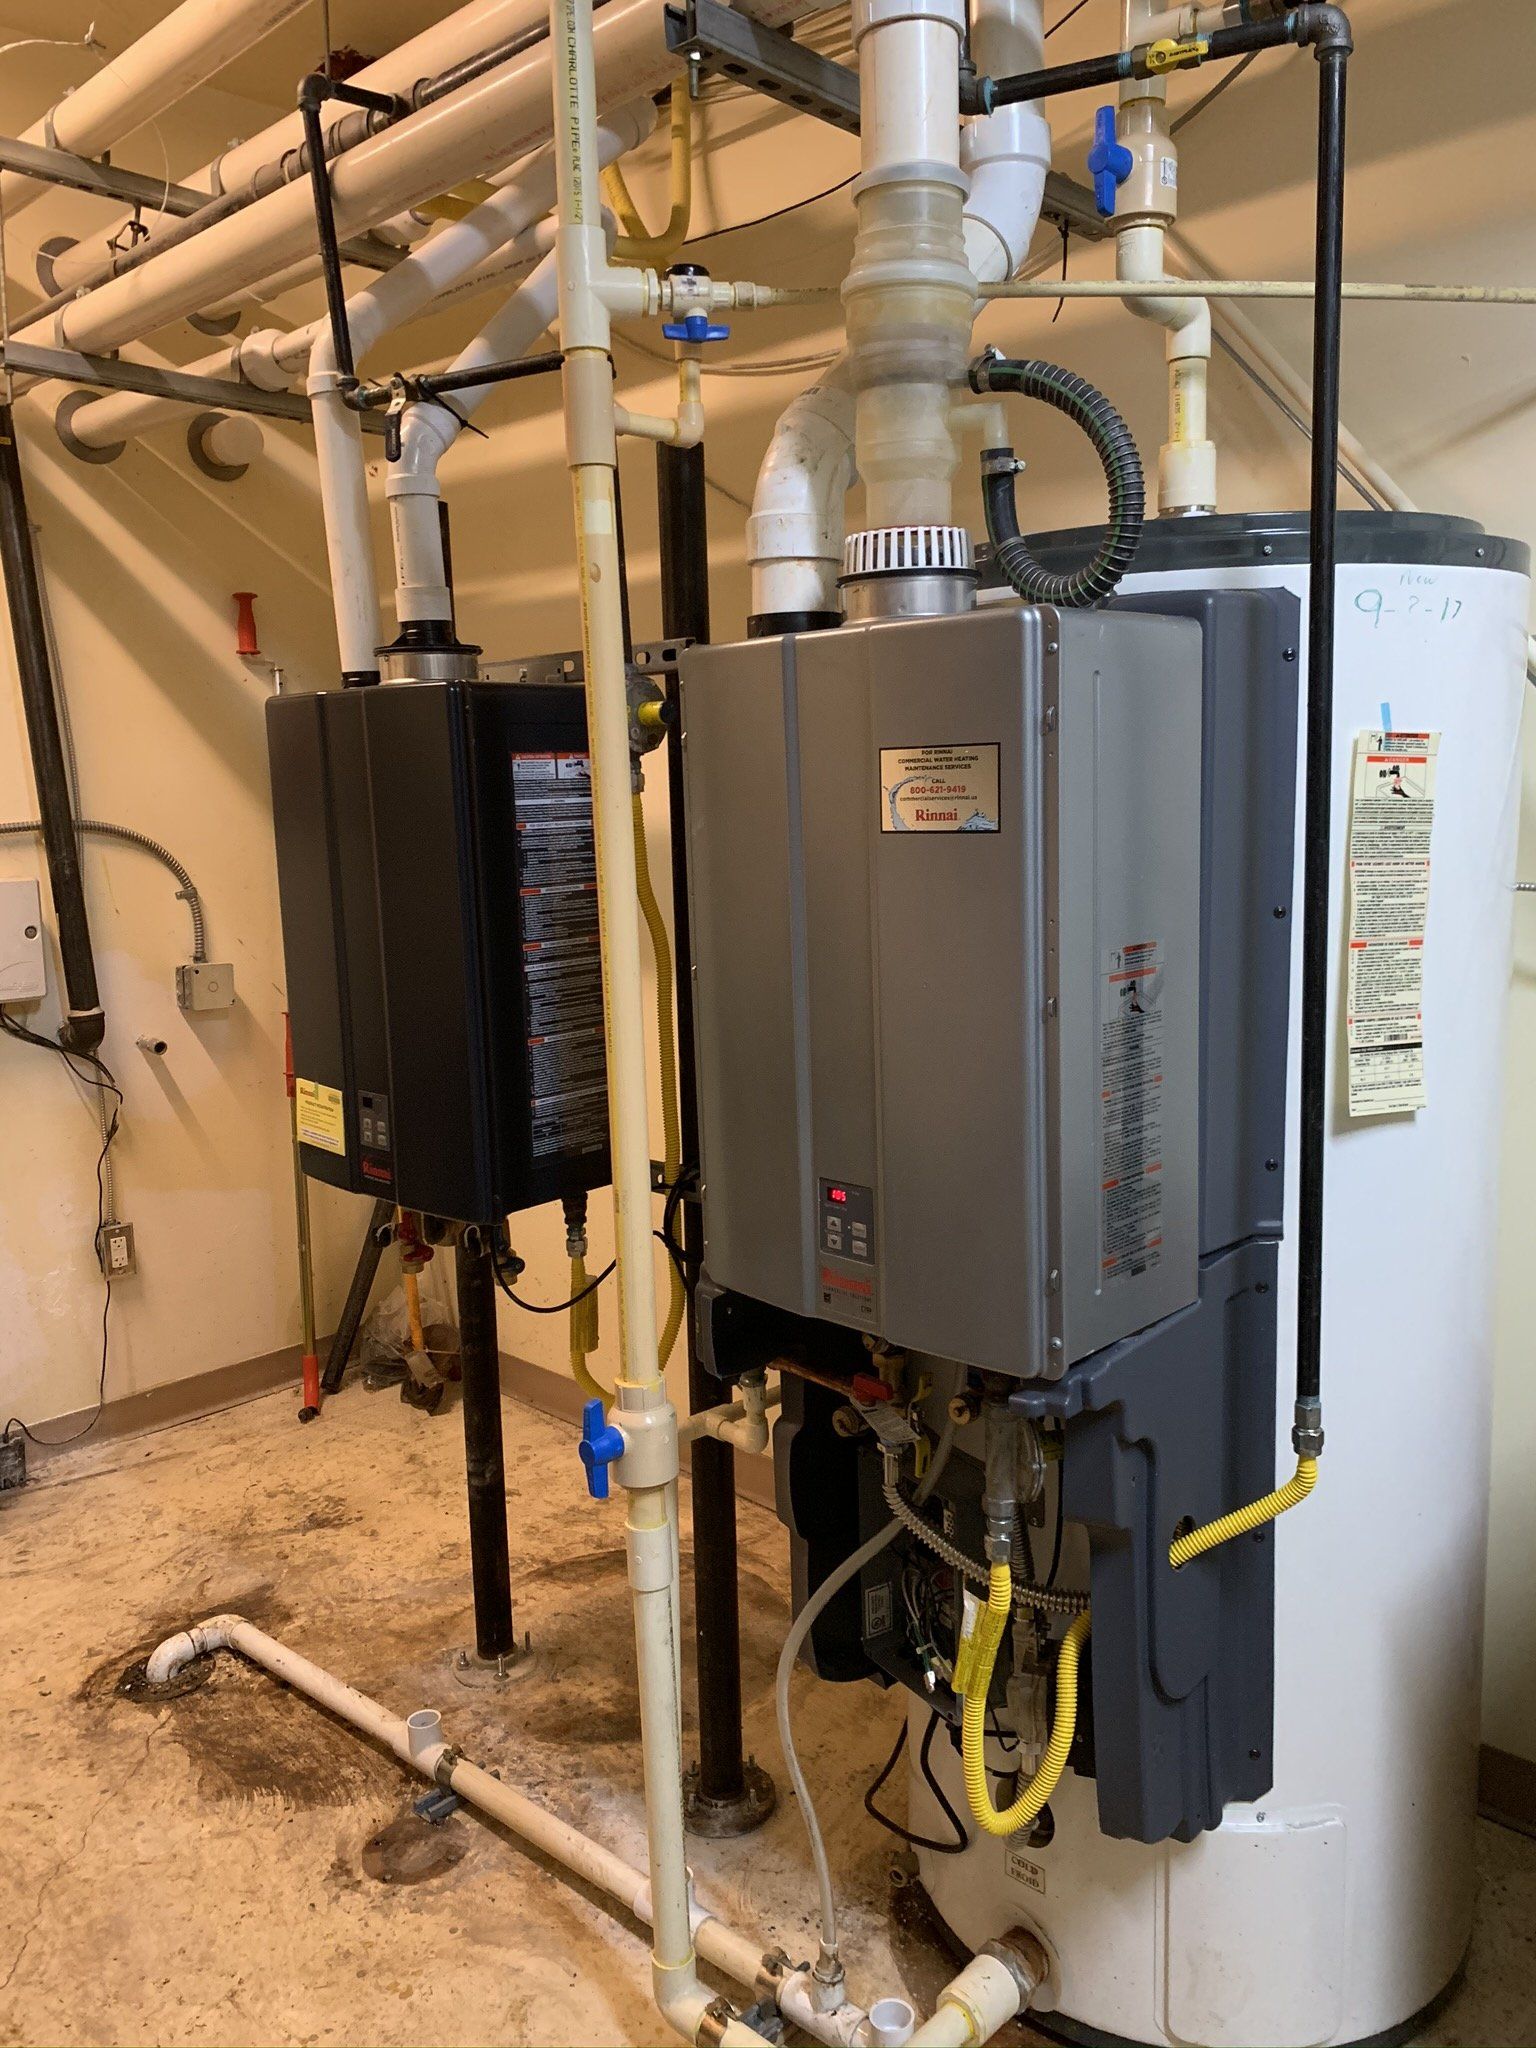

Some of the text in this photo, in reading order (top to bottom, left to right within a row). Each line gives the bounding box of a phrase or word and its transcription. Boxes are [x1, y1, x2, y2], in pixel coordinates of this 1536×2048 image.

[567, 36, 579, 110] CHARLOTTE
[909, 785, 967, 794] 800-621-9419
[915, 808, 958, 822] Rinnai
[1011, 1856, 1038, 1875] COLD
[1011, 1867, 1040, 1888] FROID
